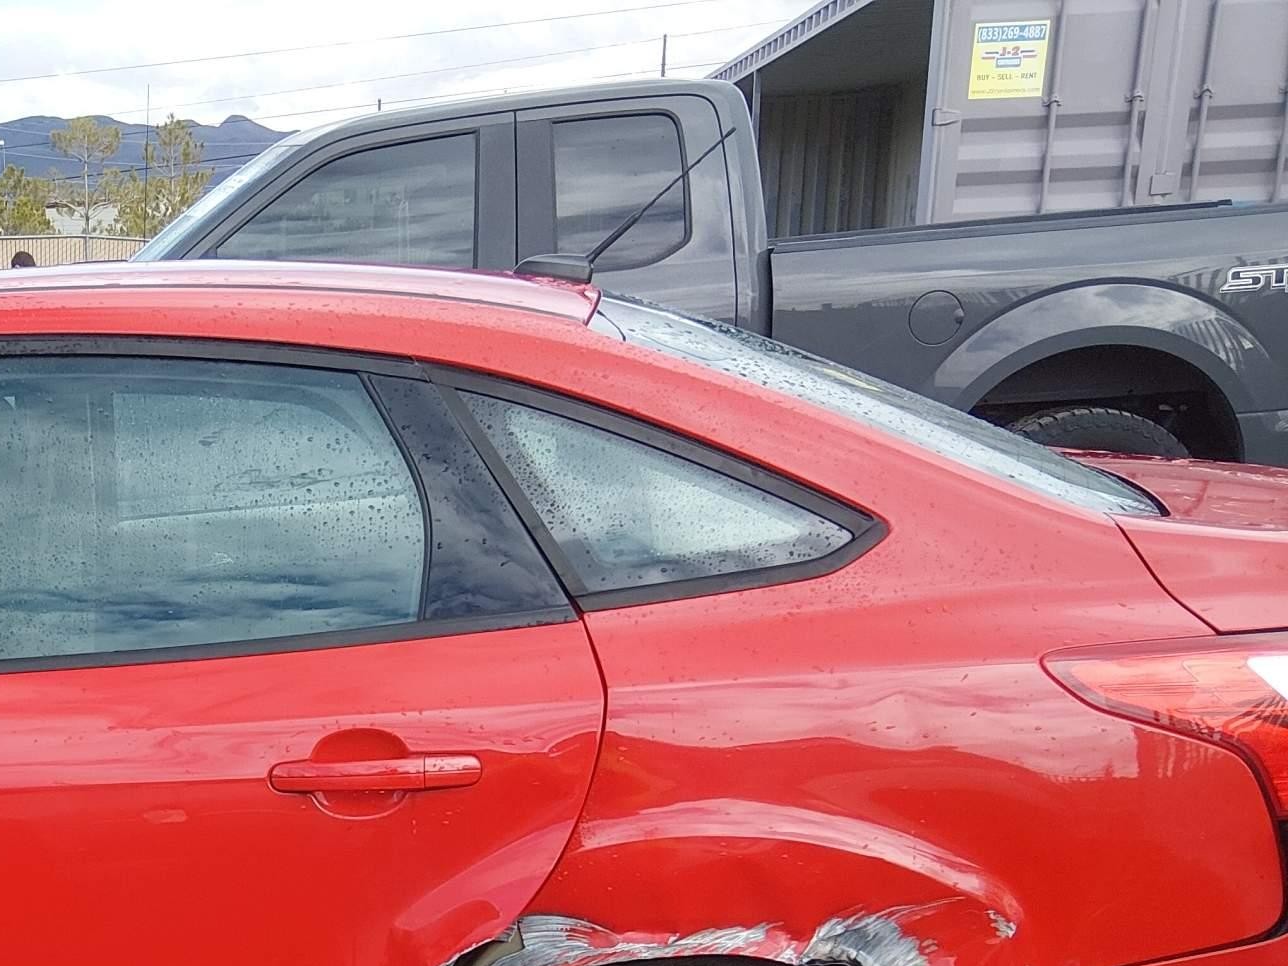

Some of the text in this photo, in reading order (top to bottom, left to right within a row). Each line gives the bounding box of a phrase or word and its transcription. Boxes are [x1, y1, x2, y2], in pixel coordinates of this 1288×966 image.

[978, 25, 1046, 42] (833)269-4887
[997, 73, 1013, 81] SELL
[1219, 264, 1288, 293] ST
